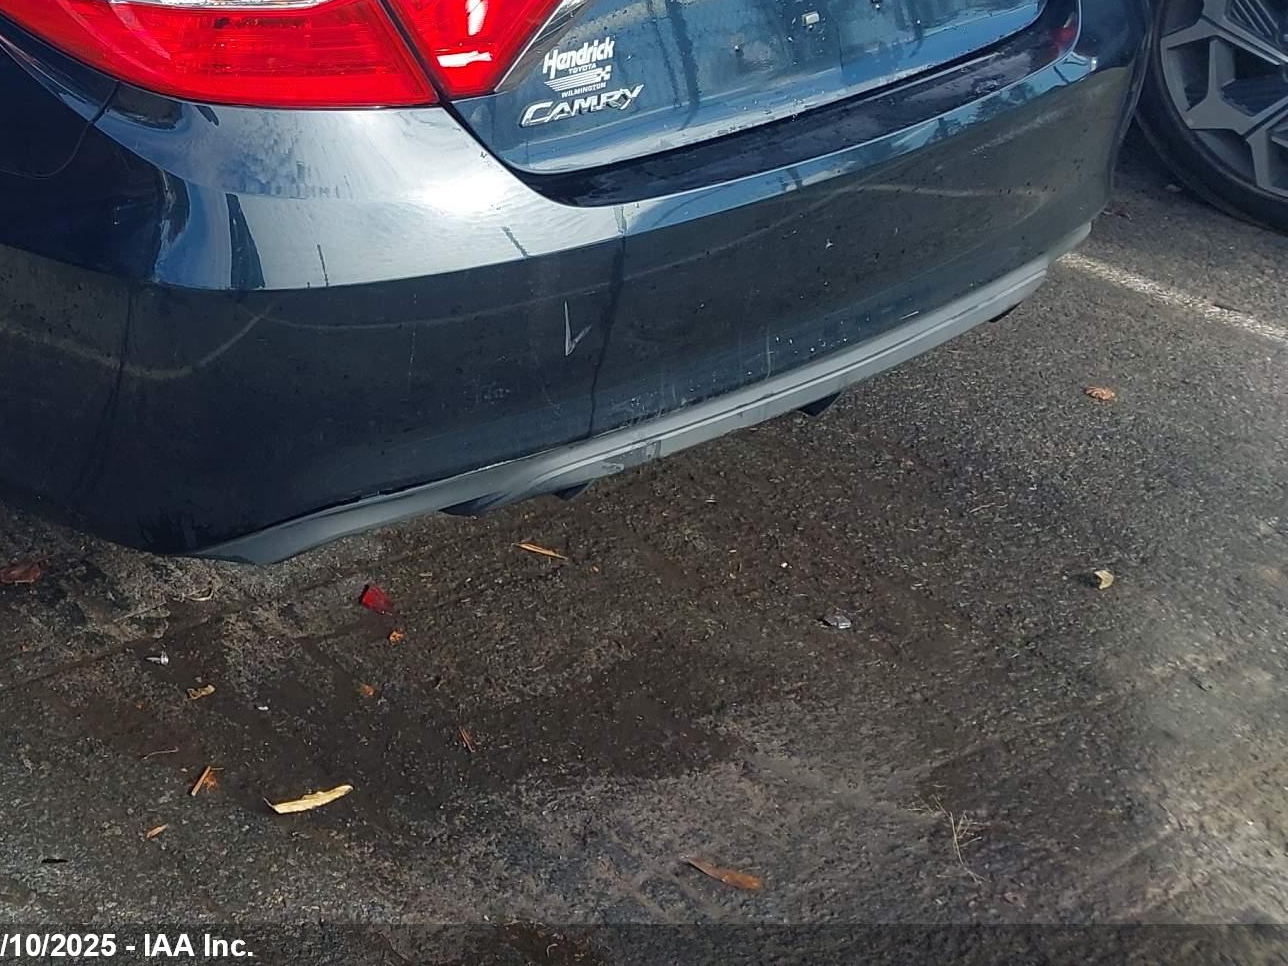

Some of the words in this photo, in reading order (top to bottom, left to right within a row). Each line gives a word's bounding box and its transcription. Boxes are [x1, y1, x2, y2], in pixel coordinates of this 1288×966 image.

[542, 36, 615, 80] Hendrick
[568, 62, 597, 75] TOYOTA
[519, 83, 645, 128] CAMRY
[561, 81, 607, 99] WILMINGTON
